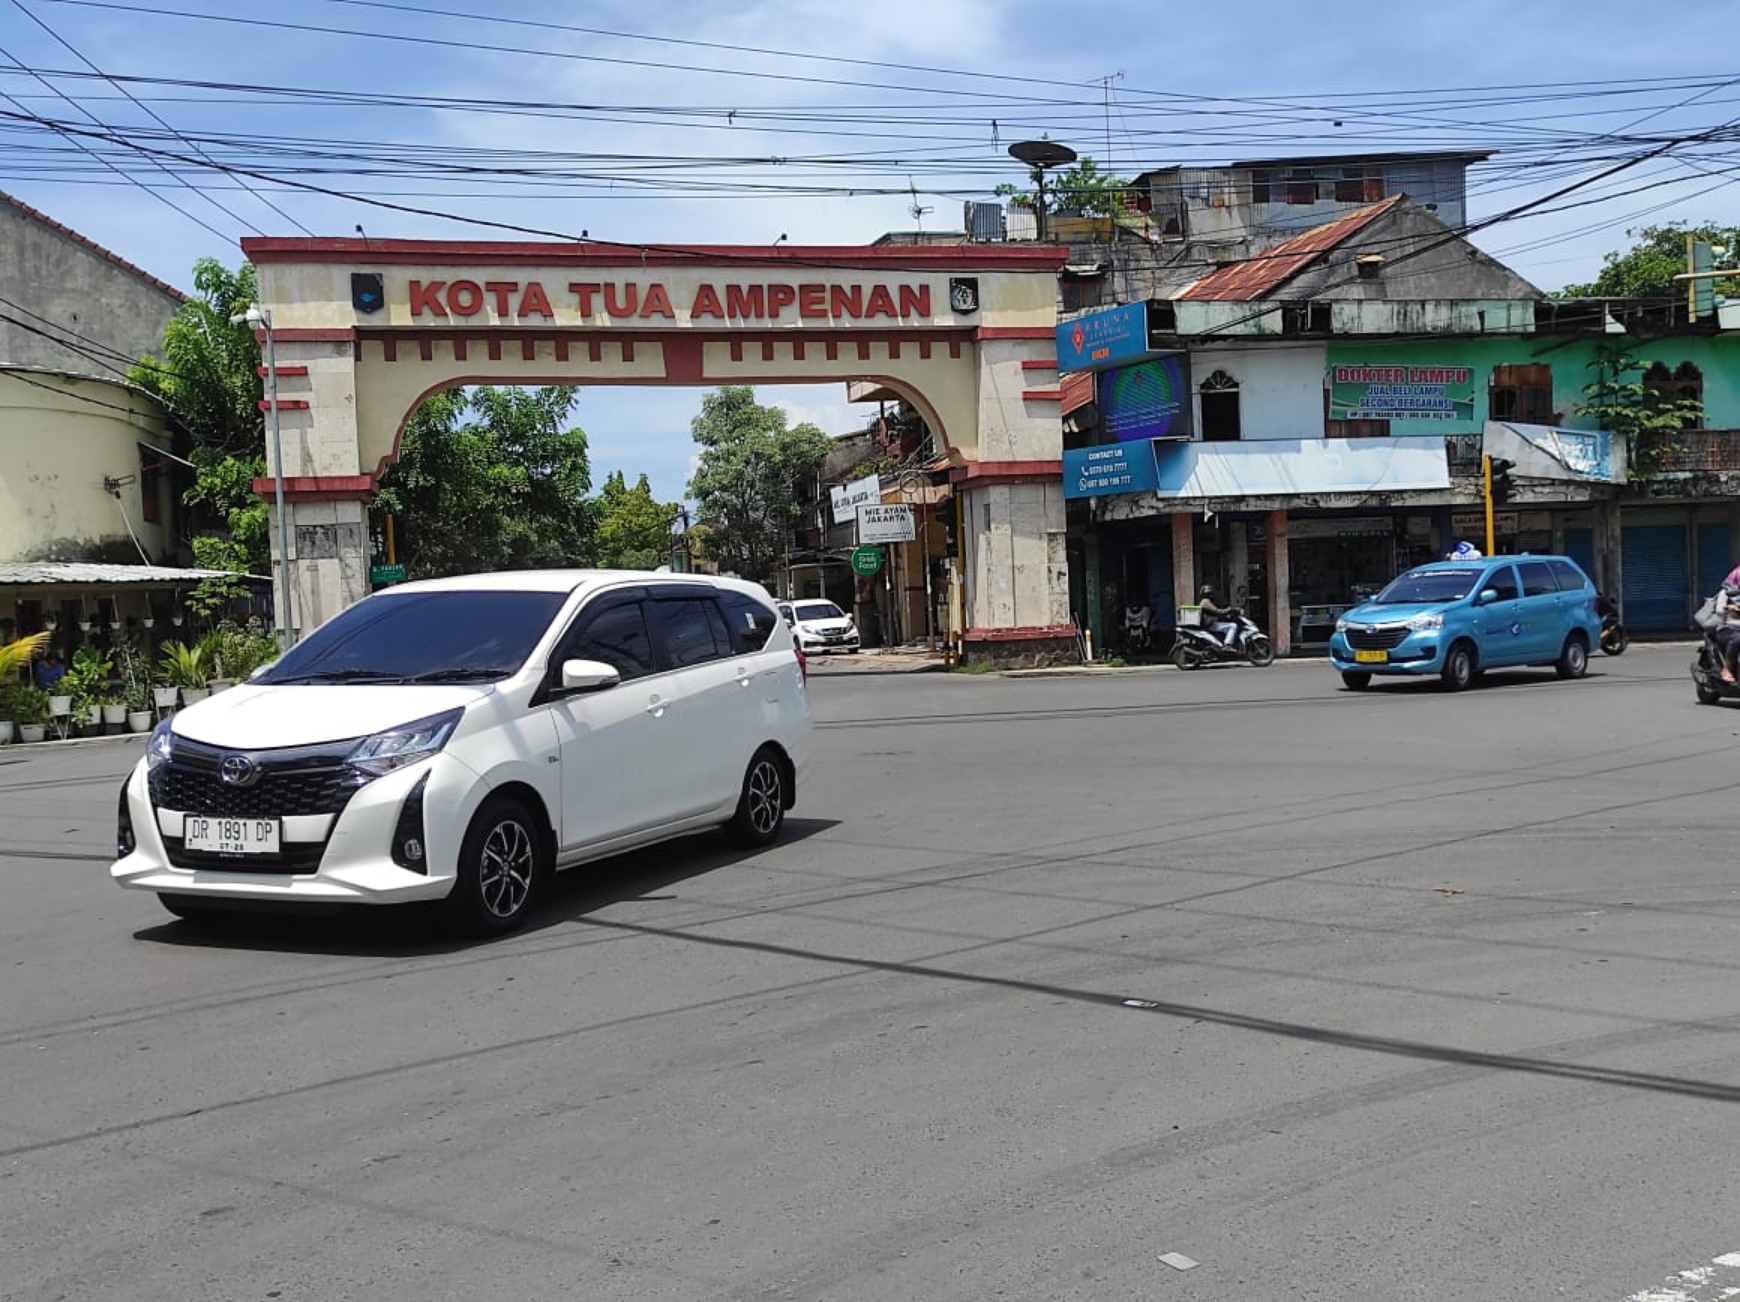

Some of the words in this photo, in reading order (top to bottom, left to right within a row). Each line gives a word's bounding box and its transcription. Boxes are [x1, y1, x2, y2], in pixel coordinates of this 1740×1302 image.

[408, 279, 554, 317] KOTA
[568, 282, 676, 318] TUA
[689, 283, 931, 318] AMPENAN
[1337, 367, 1405, 383] DOKTER
[1408, 368, 1469, 384] LAMPU
[1368, 385, 1391, 396] JUAL
[1392, 385, 1412, 396] BELI
[1413, 386, 1446, 397] LAMPU
[1359, 398, 1396, 409] SECOND
[1088, 450, 1113, 461] CONTACT
[1114, 449, 1123, 457] US
[865, 507, 881, 516] MIE
[884, 506, 907, 515] AYAM
[866, 513, 905, 524] JAKARTA
[859, 561, 877, 569] Food
[192, 819, 209, 839] DR
[218, 820, 247, 840] 1891
[256, 821, 272, 842] DP
